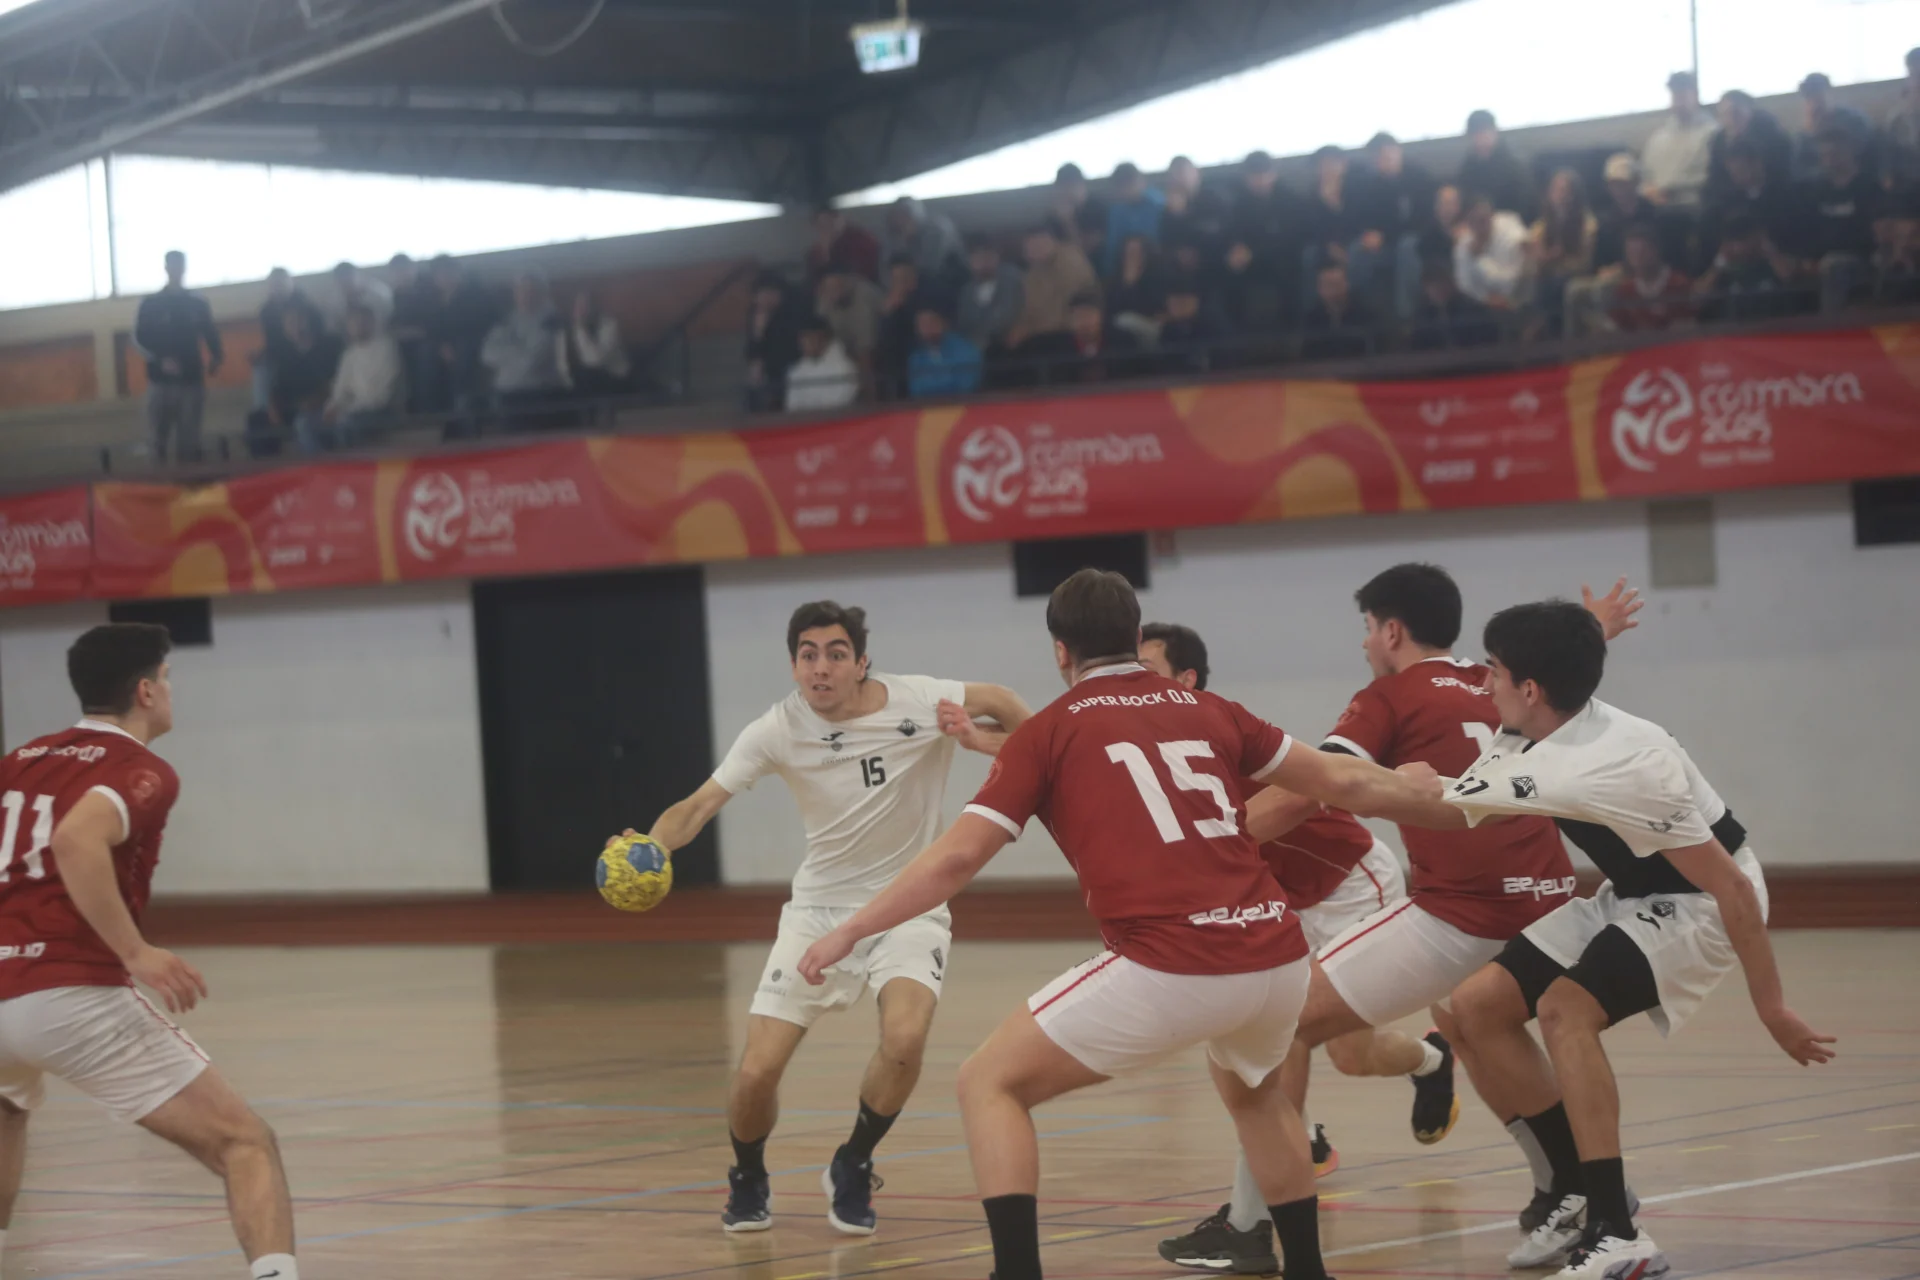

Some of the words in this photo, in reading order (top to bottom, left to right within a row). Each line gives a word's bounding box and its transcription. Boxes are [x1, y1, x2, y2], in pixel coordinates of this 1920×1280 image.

[1068, 695, 1120, 714] SUPER
[1118, 692, 1167, 706] BOCK
[1167, 689, 1198, 704] 0.0
[861, 756, 886, 788] 15
[1105, 740, 1239, 844] 15
[1, 790, 54, 883] 11
